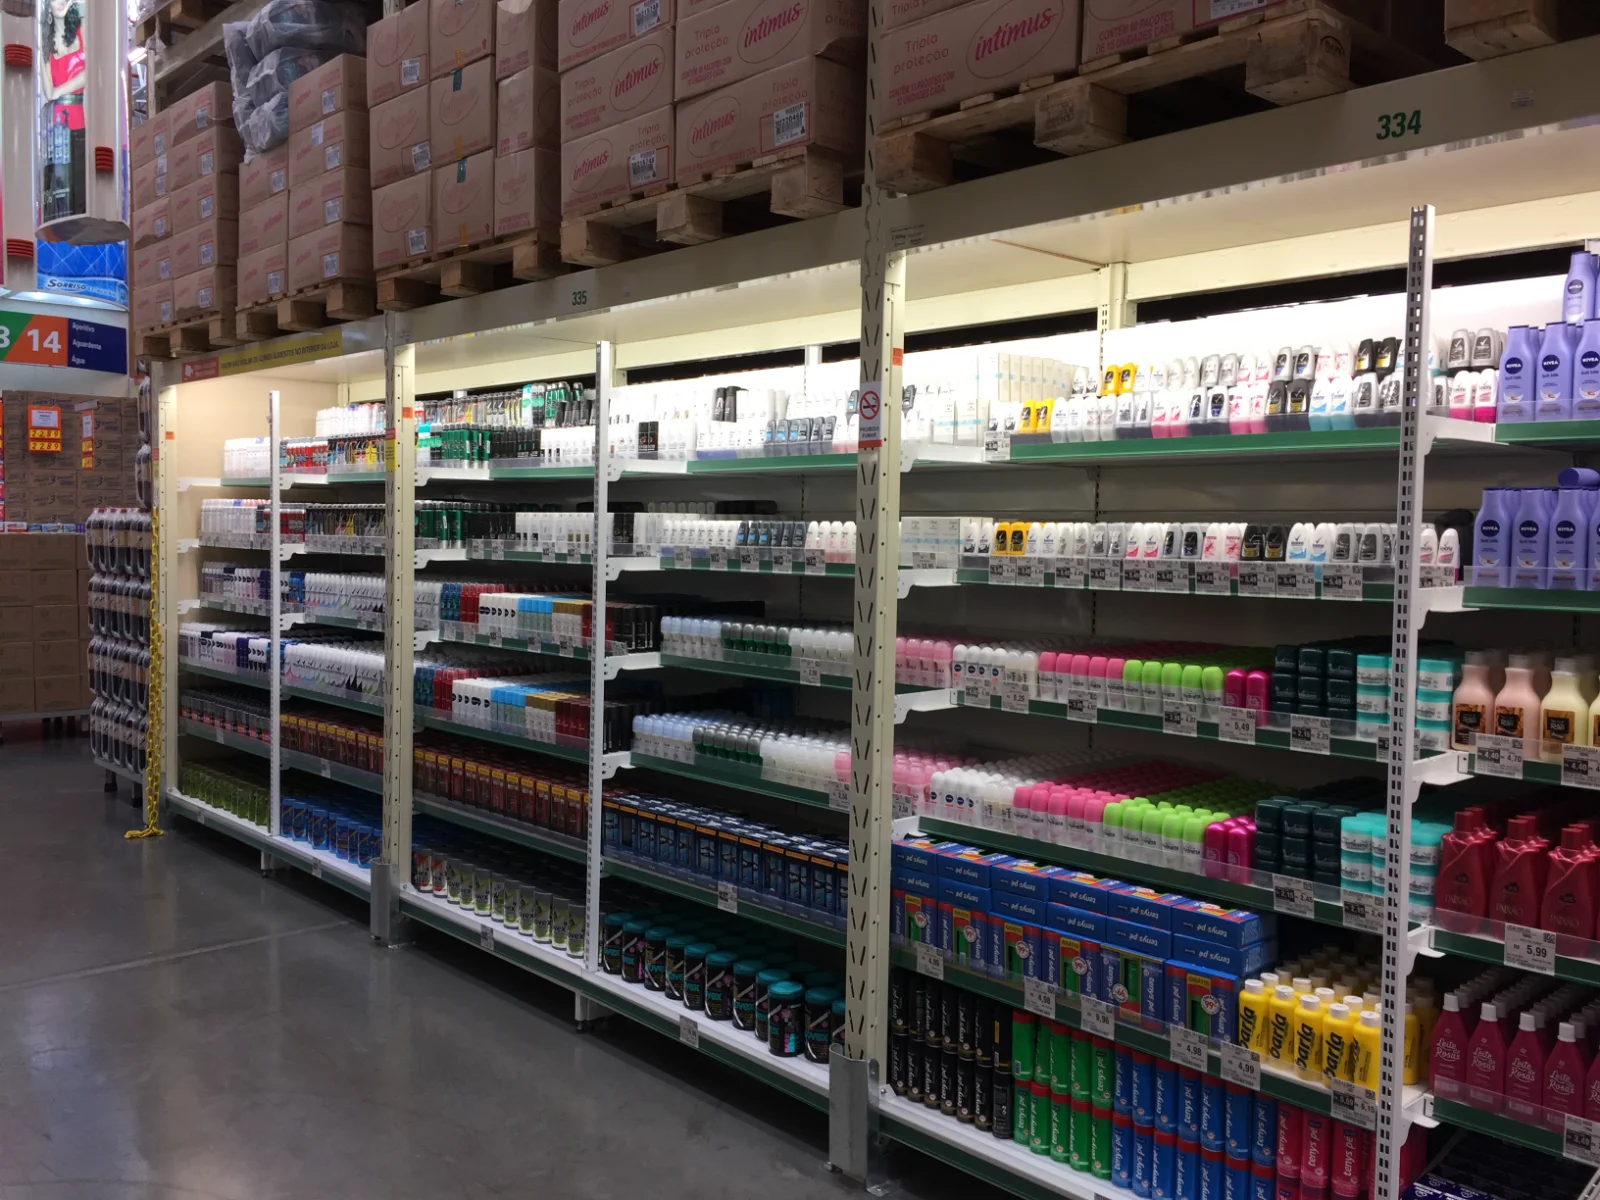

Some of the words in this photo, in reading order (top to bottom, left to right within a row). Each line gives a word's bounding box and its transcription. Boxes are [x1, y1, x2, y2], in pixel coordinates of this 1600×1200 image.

[572, 1, 611, 36] intimus
[744, 3, 805, 48] intimus
[694, 24, 720, 41] Tripla
[905, 33, 938, 53] Tripla
[975, 7, 1058, 61] intimus
[685, 36, 729, 61] proteção
[893, 47, 949, 76] proteção
[615, 58, 662, 98] intimus
[771, 77, 798, 93] Tripla
[638, 124, 660, 137] Tripla
[692, 110, 737, 145] intimus
[1375, 109, 1422, 140] 334
[573, 151, 609, 180] intimus
[47, 279, 87, 290] SORRISO
[572, 290, 588, 306] 335
[27, 328, 62, 353] 14
[1582, 356, 1600, 364] NIVEA
[1526, 944, 1547, 958] 5,99
[1269, 1012, 1287, 1059] barla
[1436, 1037, 1457, 1050] Leite
[1295, 1023, 1313, 1071] barla
[1323, 1031, 1342, 1080] barla
[1434, 1048, 1461, 1062] Rosas
[1473, 1046, 1492, 1060] Leite
[1238, 1062, 1255, 1075] 4,99
[1471, 1057, 1496, 1072] Rosas
[1509, 1067, 1536, 1083] Rosas
[1512, 1057, 1532, 1071] Leite
[1097, 1069, 1105, 1091] tenys
[1550, 1069, 1571, 1083] Leite
[1547, 1080, 1576, 1096] Rosas
[1184, 1101, 1192, 1124] tenys
[1257, 1123, 1267, 1147] tenys
[1279, 1130, 1288, 1155] tenys
[1308, 1141, 1318, 1167] tenys
[1343, 1151, 1353, 1177] tenys
